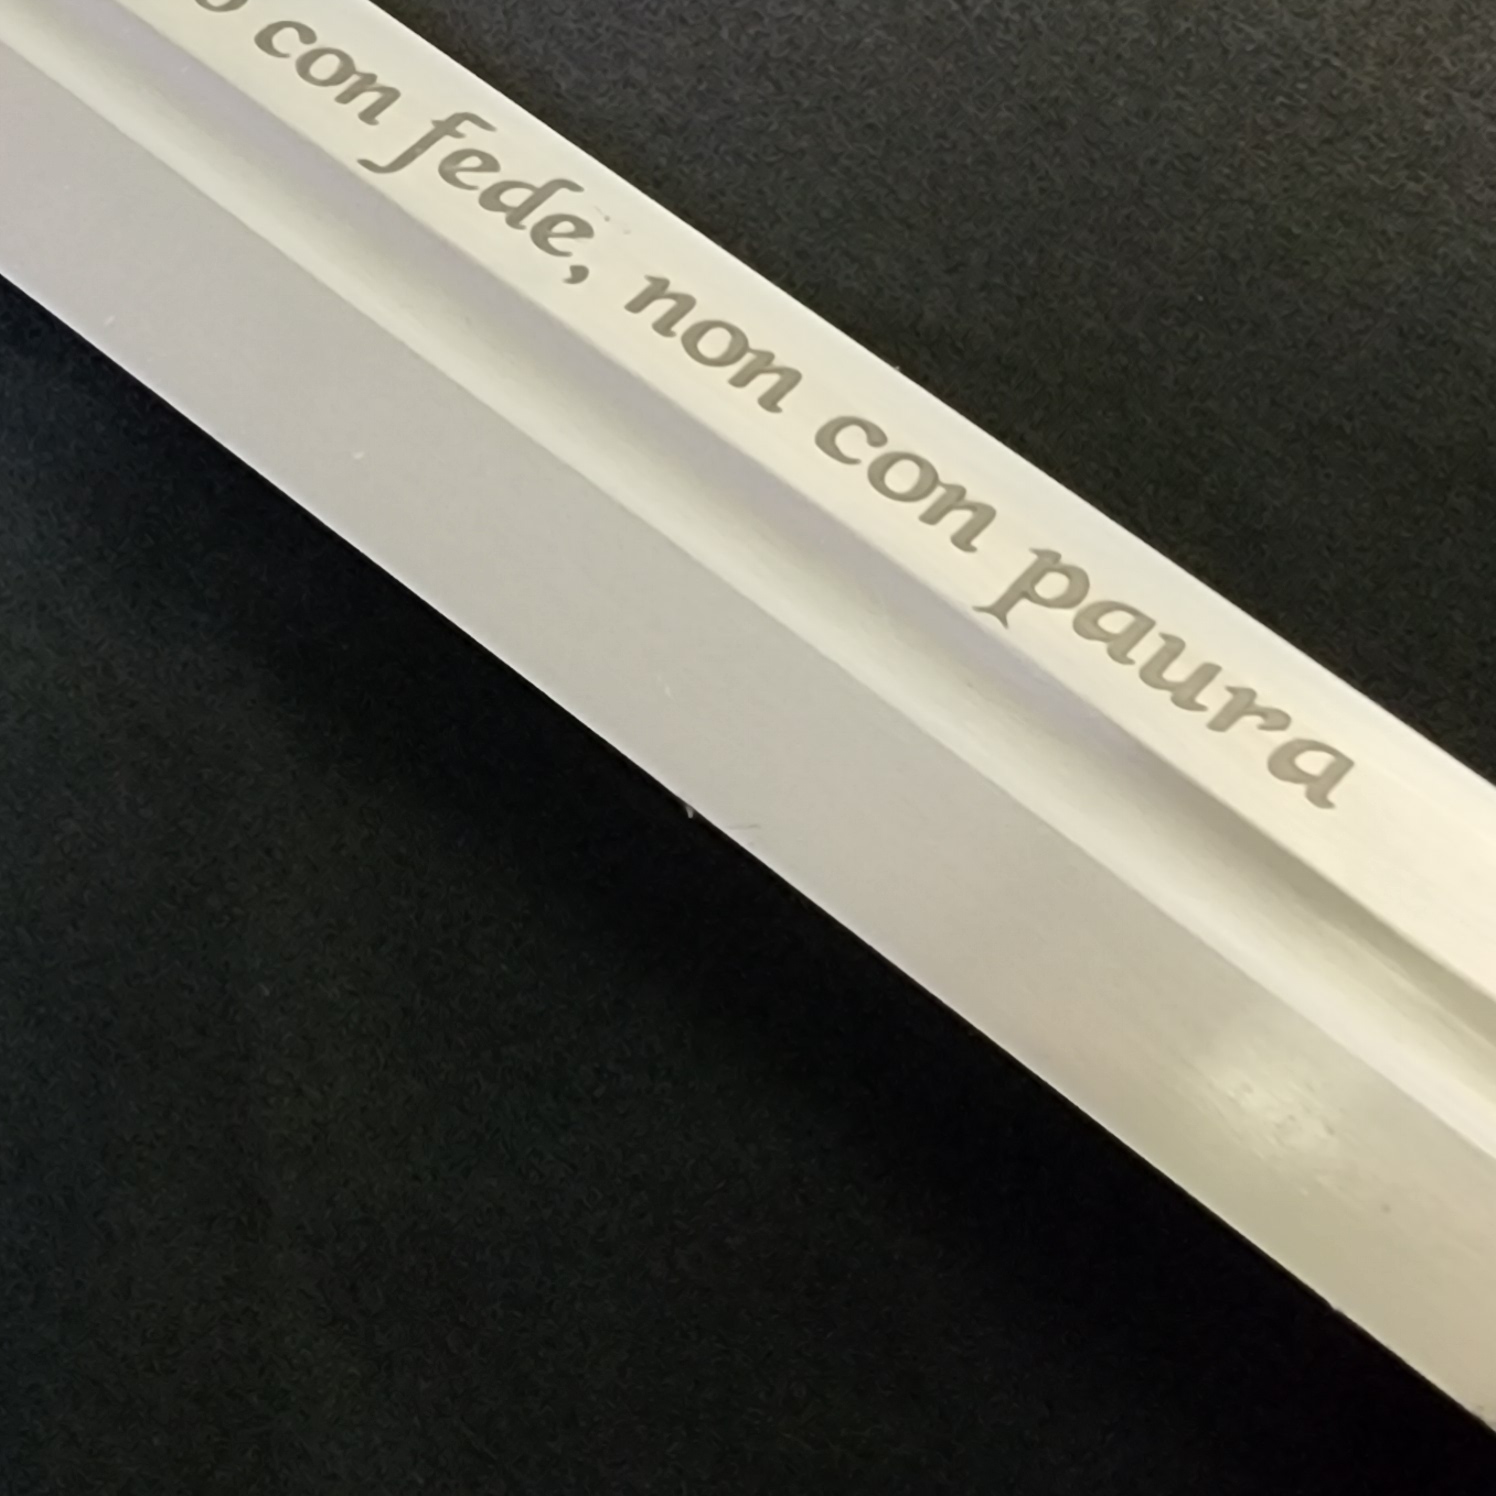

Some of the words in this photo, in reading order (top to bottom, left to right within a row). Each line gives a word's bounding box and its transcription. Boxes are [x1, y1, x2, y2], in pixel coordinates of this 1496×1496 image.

[254, 20, 401, 126] con
[357, 112, 594, 284] fede,
[624, 275, 802, 414] non
[814, 415, 997, 553] con
[973, 547, 1355, 810] paura
